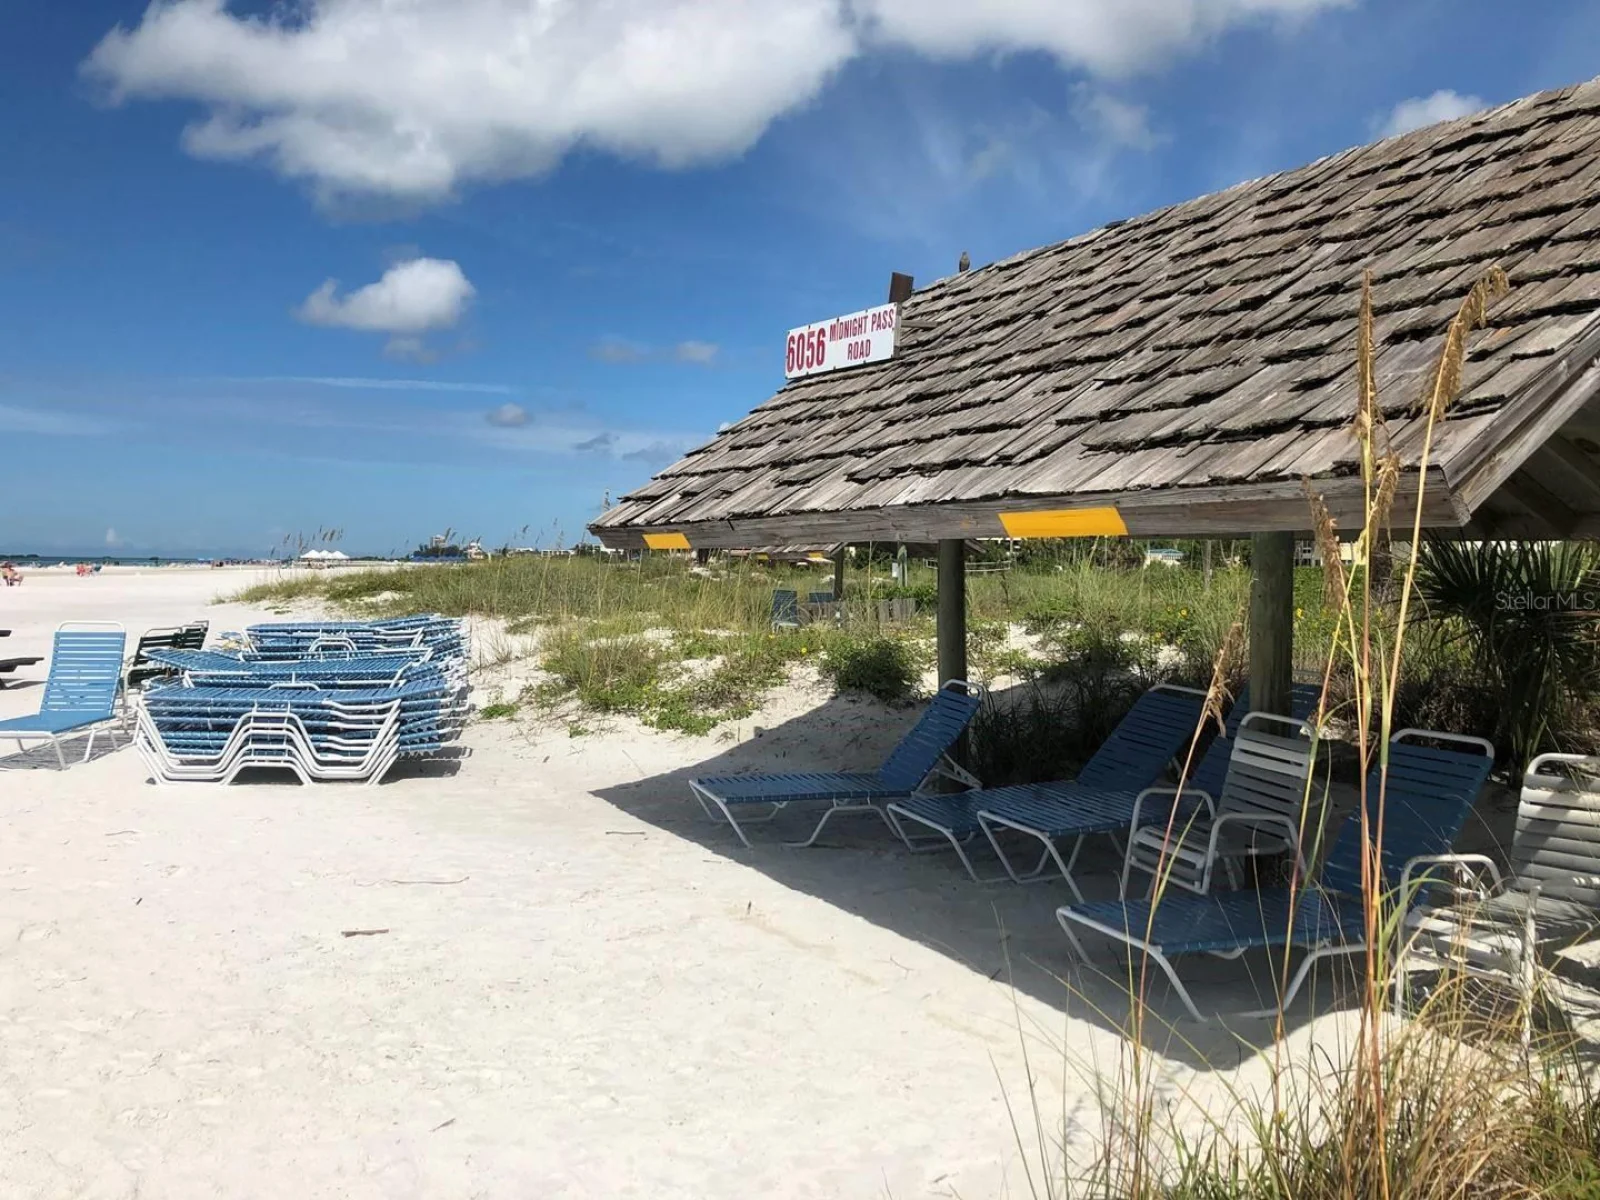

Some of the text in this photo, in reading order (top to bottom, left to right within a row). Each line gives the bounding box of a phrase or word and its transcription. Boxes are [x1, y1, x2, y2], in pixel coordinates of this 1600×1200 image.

[829, 308, 894, 342] MIDNIGHT PASS
[786, 327, 826, 373] 6056
[847, 339, 871, 360] ROAD
